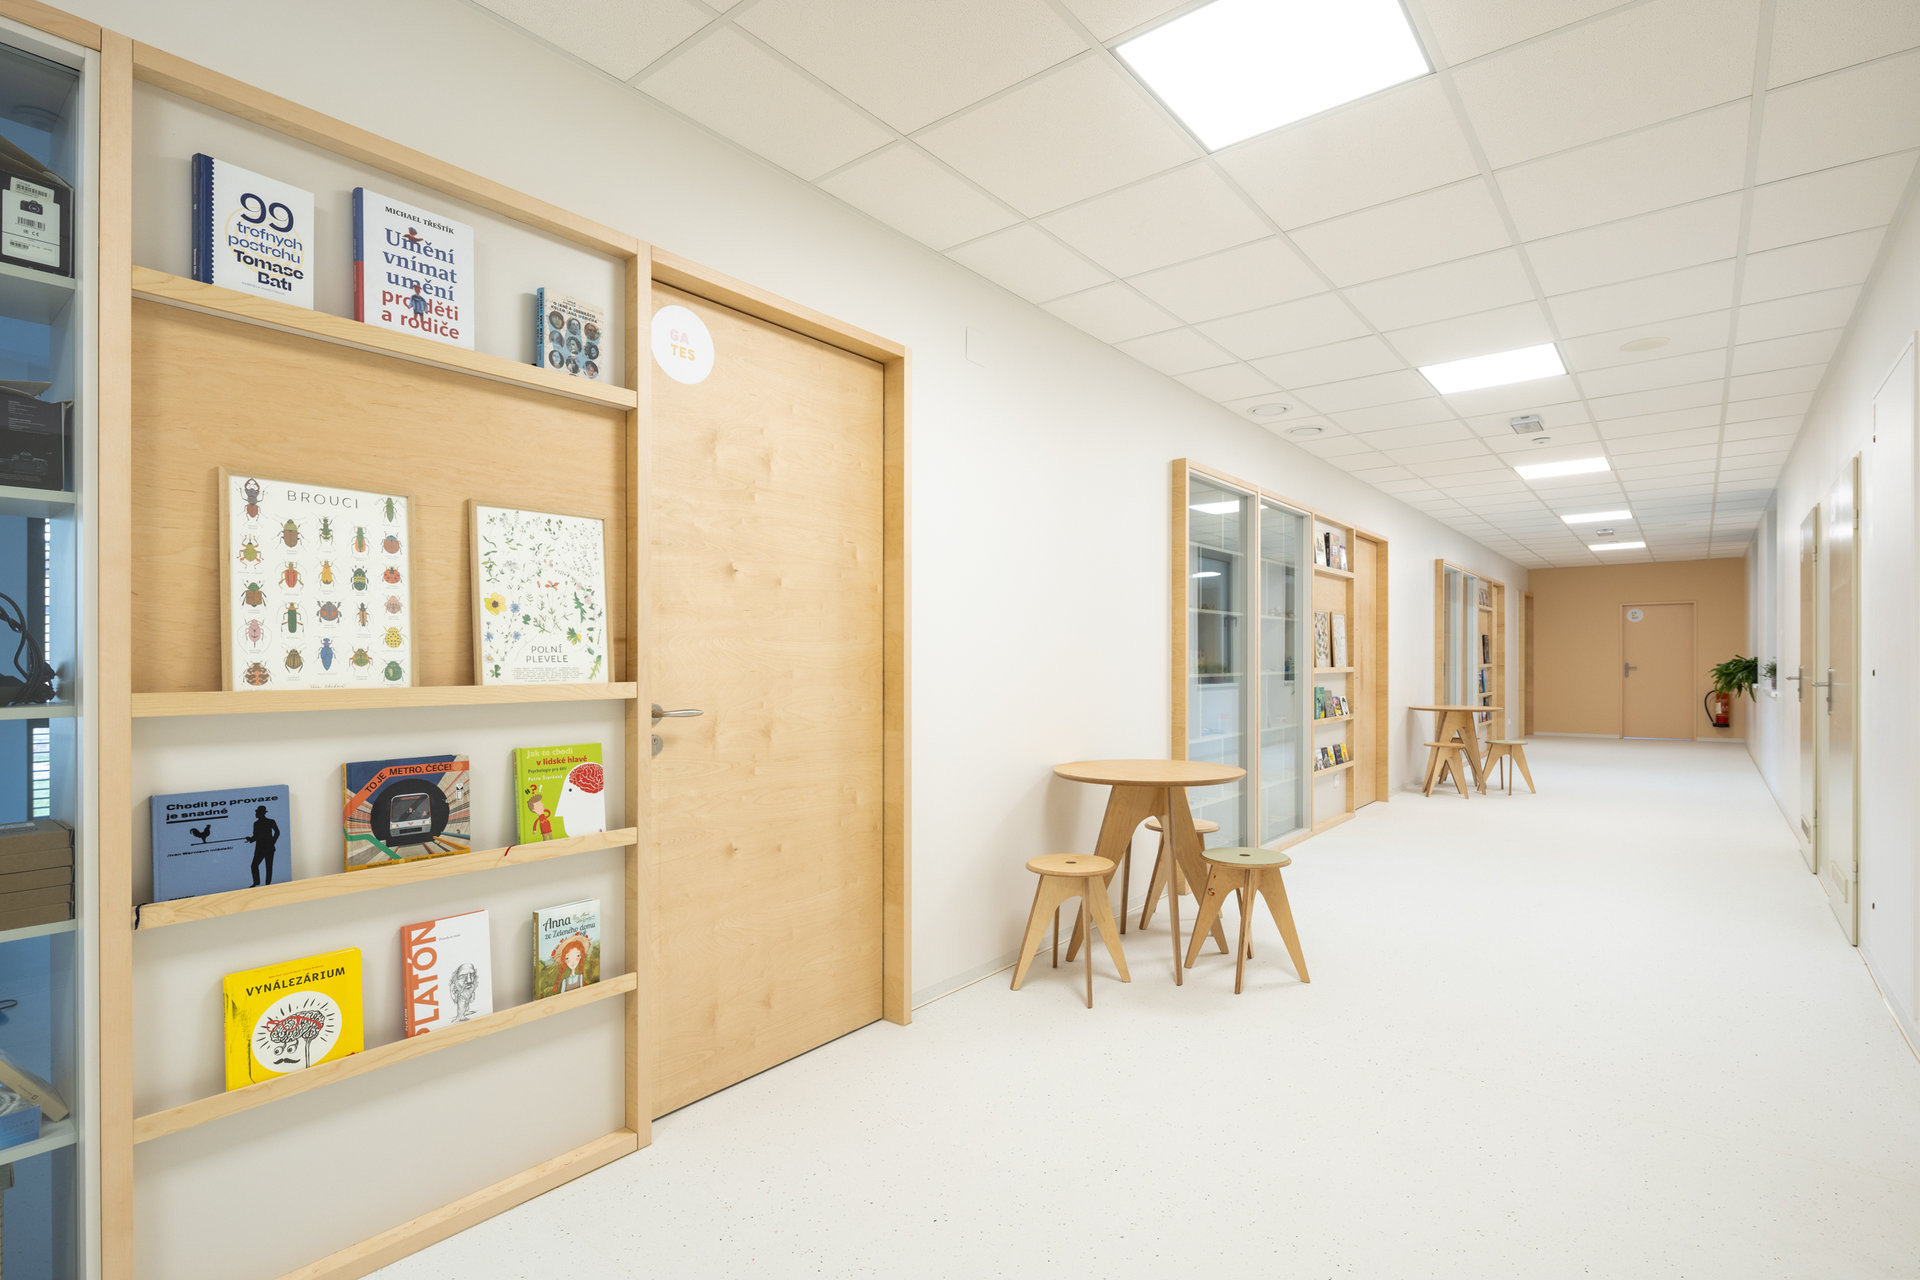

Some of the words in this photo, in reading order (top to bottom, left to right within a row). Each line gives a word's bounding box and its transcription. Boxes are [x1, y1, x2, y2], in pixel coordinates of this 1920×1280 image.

[239, 192, 294, 233] 99
[385, 206, 422, 224] MICHAEL
[423, 219, 455, 235] TŘEŠTÍK
[384, 227, 455, 265] Umění
[382, 250, 458, 284] vnímat
[385, 271, 455, 302] umění
[381, 308, 393, 323] a
[400, 313, 460, 341] rodiče
[287, 490, 358, 509] BROUCI
[526, 654, 568, 663] PLEVELE
[531, 643, 562, 654] POLNÍ
[543, 756, 566, 766] lidské
[364, 781, 378, 793] TO
[377, 771, 387, 783] JE
[389, 765, 424, 775] METRO,
[166, 801, 208, 811] Chodit
[229, 795, 279, 806] provaze
[166, 813, 178, 821] je
[181, 808, 228, 819] snadné
[543, 916, 571, 932] Anna
[246, 967, 345, 996] VYNÁLEZÁRIUM
